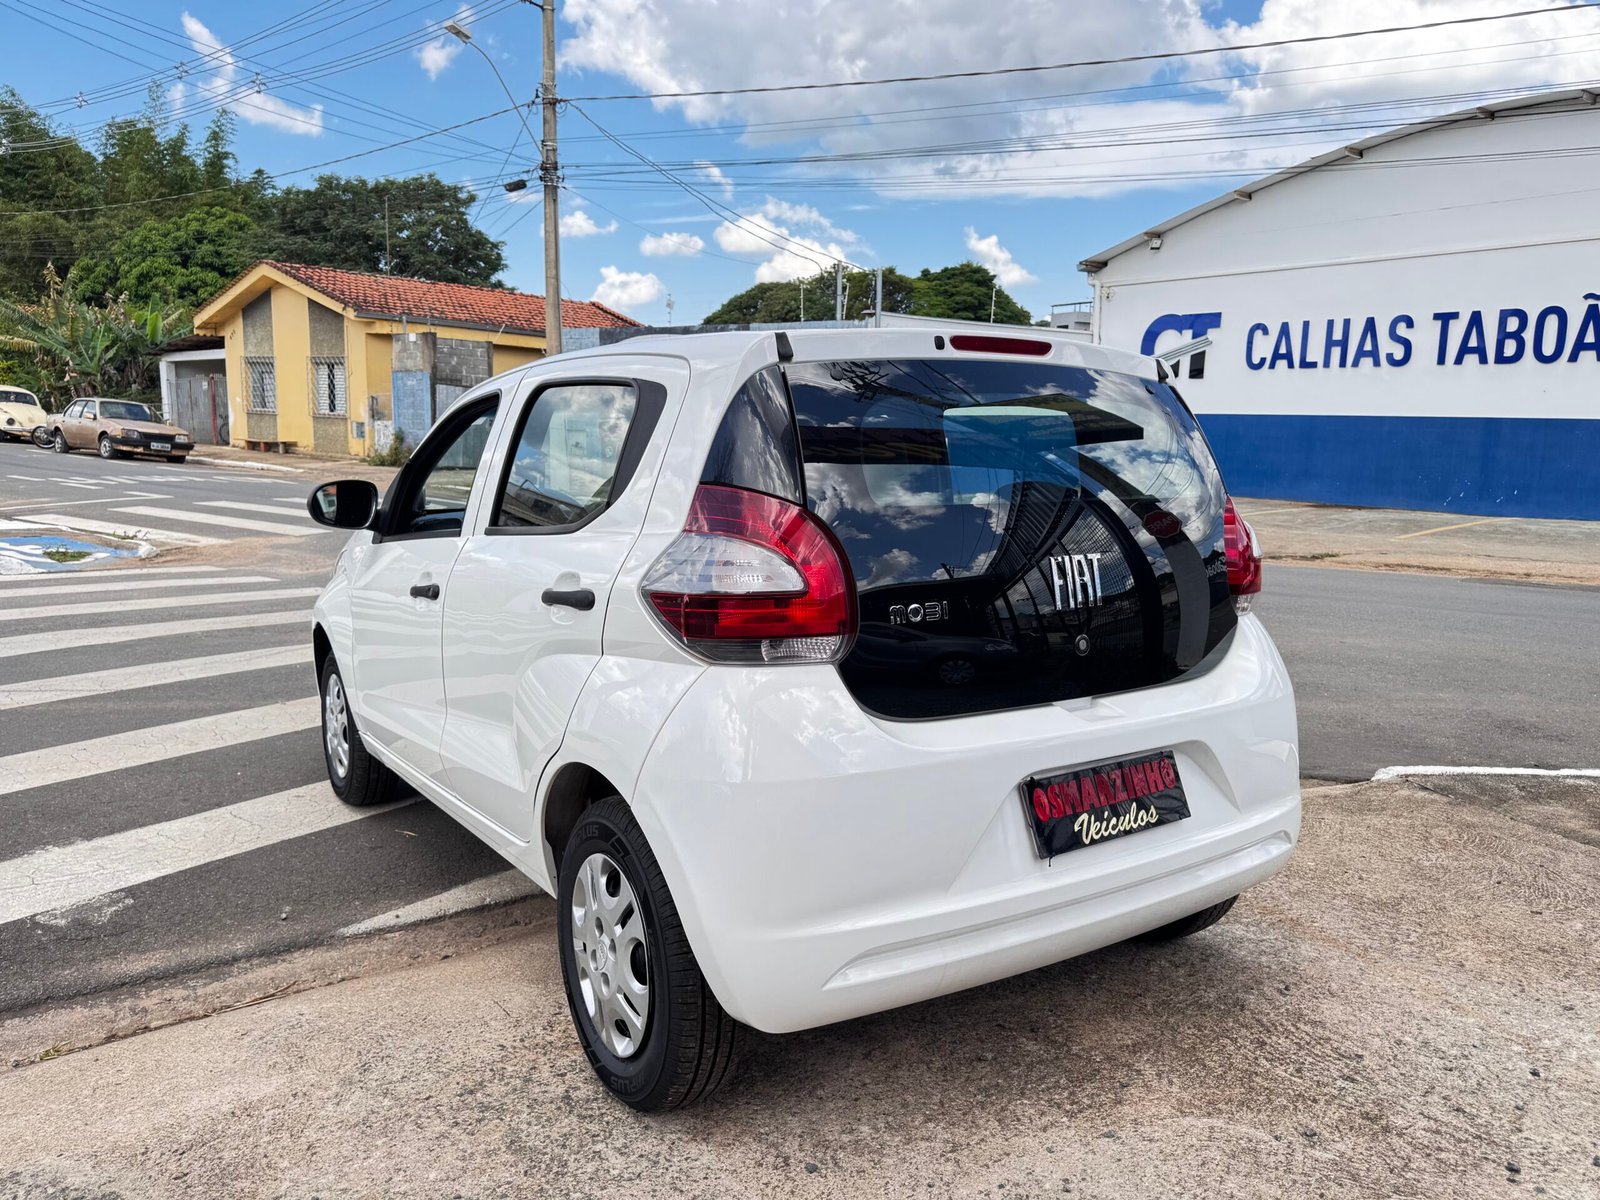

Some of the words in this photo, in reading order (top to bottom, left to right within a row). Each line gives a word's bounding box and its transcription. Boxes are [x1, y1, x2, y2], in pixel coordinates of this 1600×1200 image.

[1245, 314, 1414, 370] CALHAS
[1432, 292, 1600, 366] TABOÃ
[1050, 553, 1102, 611] FIAT
[889, 600, 949, 625] MOBI
